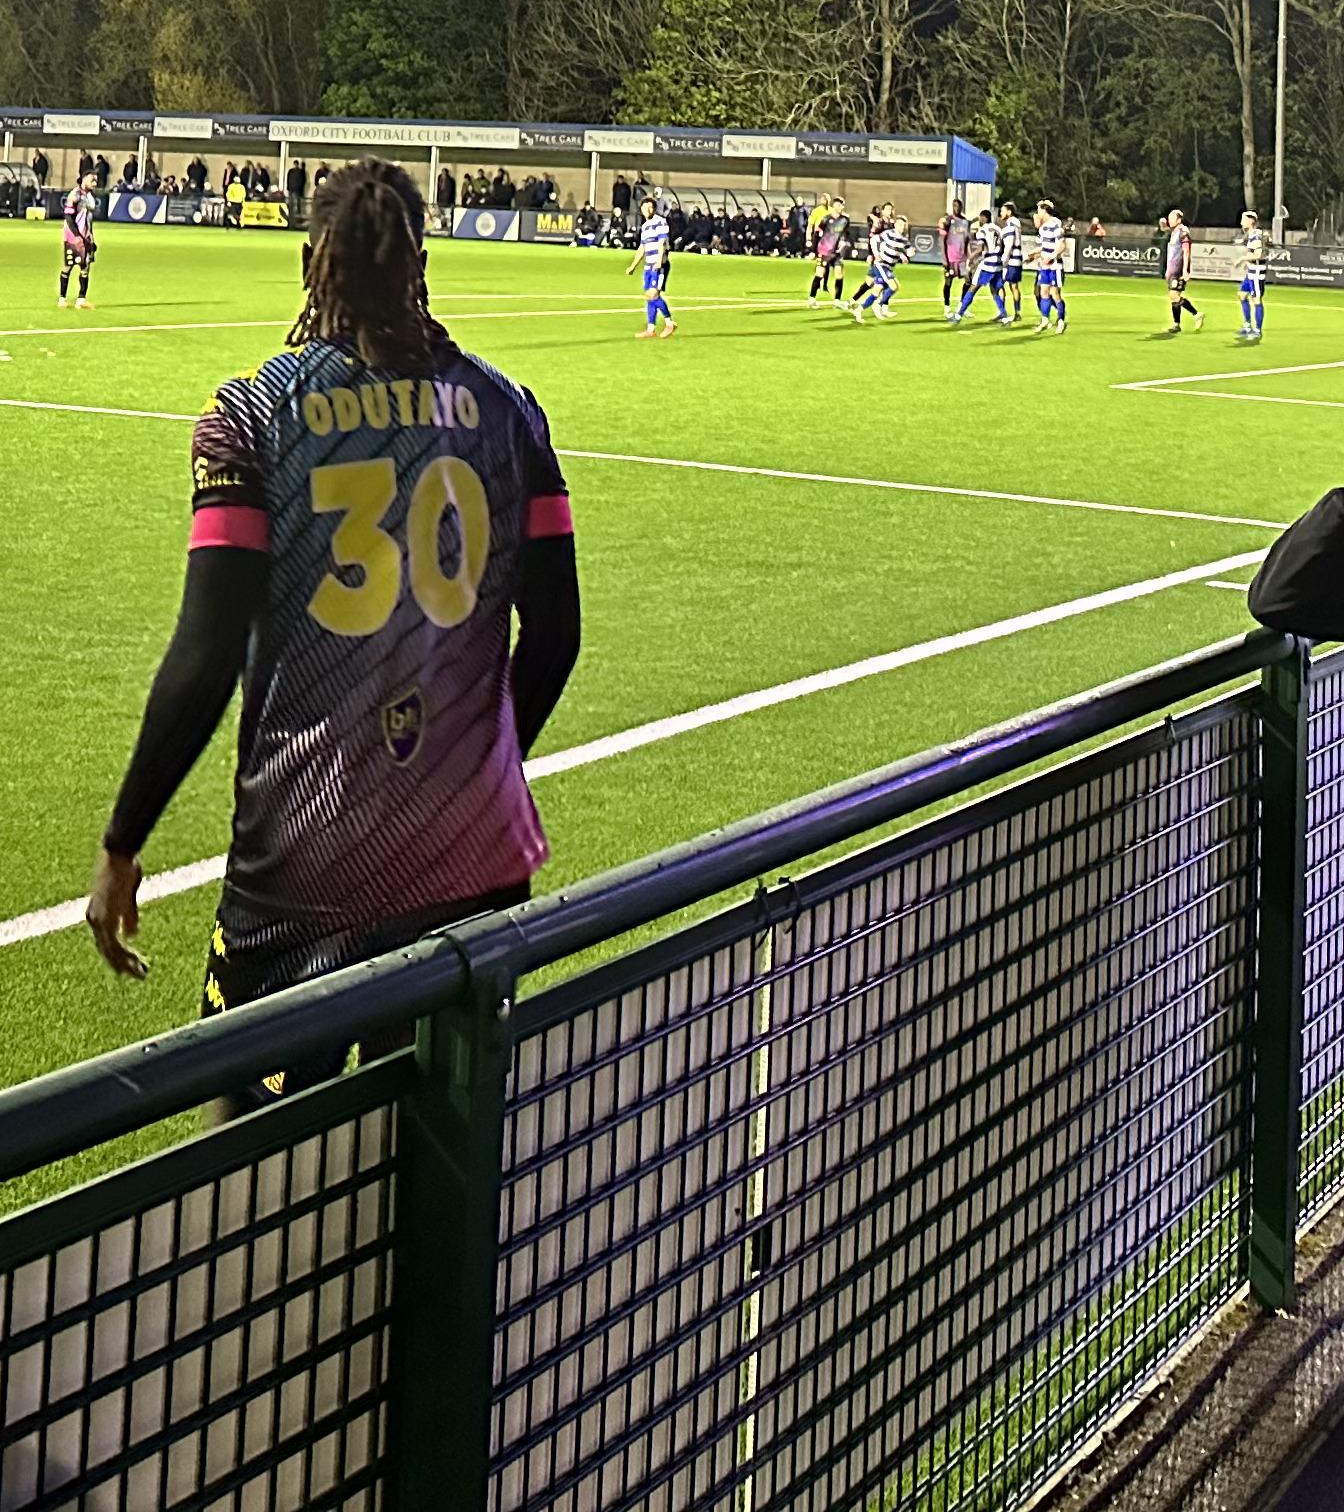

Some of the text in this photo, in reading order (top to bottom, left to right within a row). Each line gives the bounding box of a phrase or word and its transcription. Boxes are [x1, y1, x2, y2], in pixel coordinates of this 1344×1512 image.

[272, 125, 450, 142] OXFORD CITY FOOTBALL CLUB
[670, 138, 720, 150] TREE CARE
[812, 144, 866, 154] TREE CARE
[303, 379, 480, 436] ODUTAYO
[308, 455, 490, 637] 30
